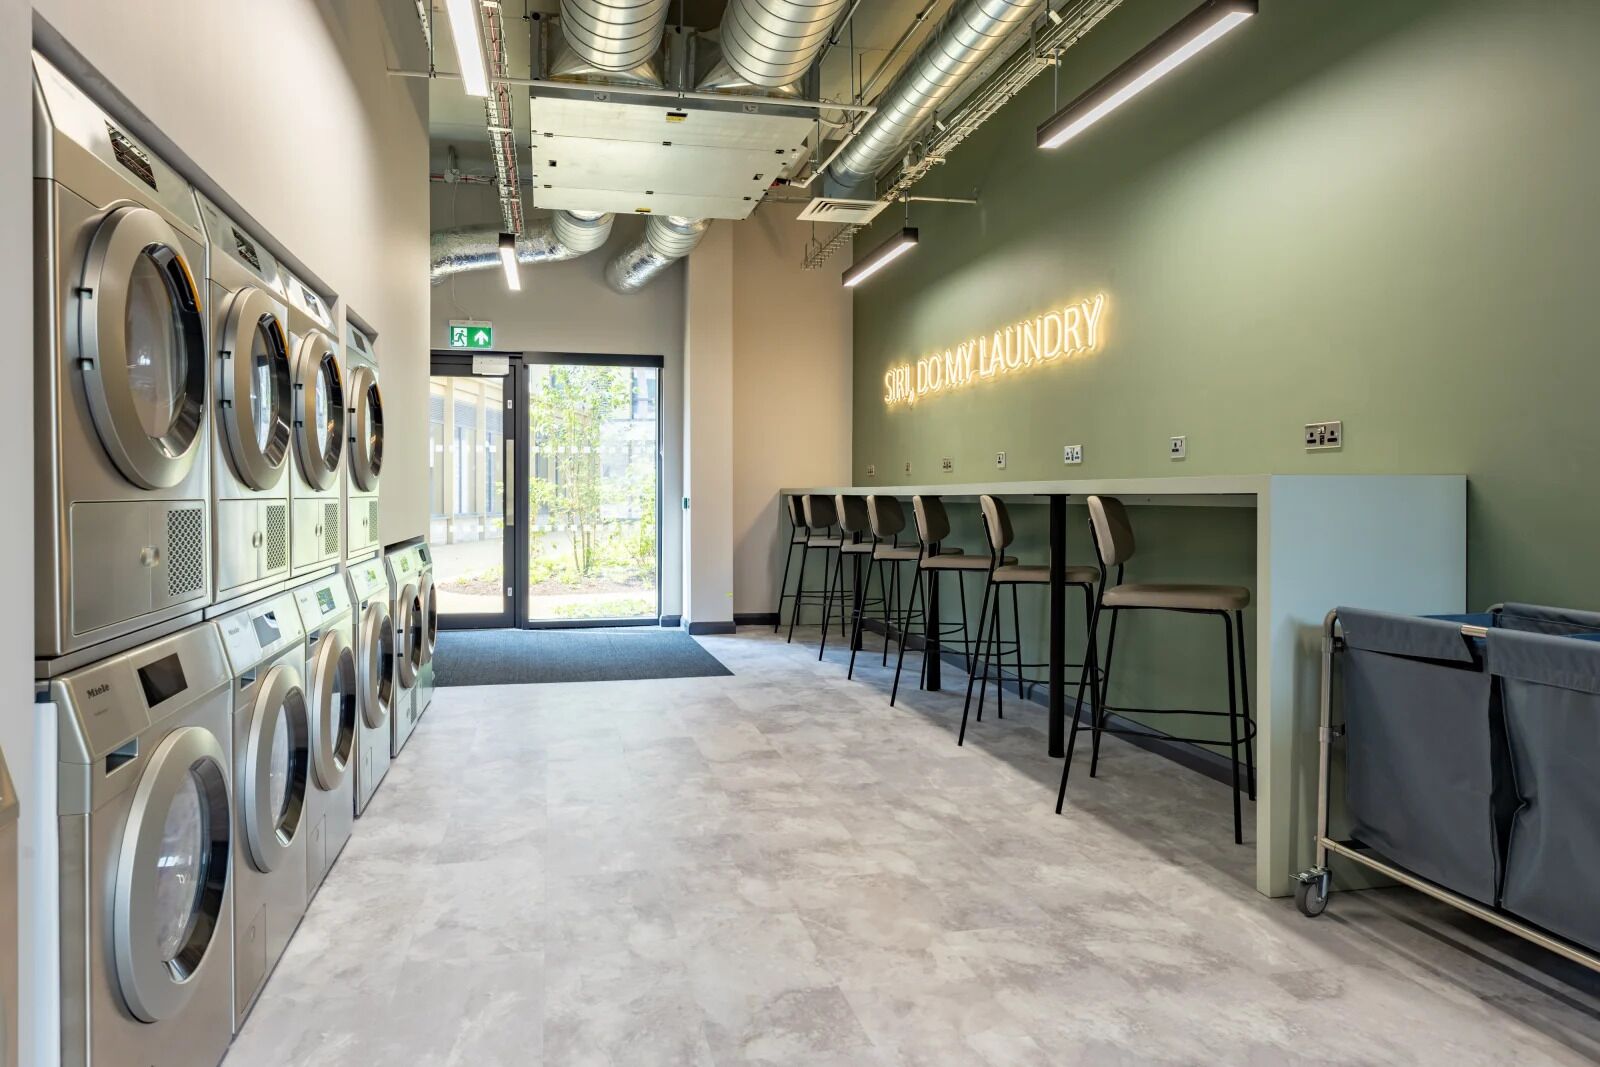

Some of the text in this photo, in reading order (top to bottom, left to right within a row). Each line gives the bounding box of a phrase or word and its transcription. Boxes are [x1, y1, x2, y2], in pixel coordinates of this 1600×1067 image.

[885, 293, 1105, 403] SIRI, DO MY LAUNDRY
[87, 684, 110, 699] Miele
